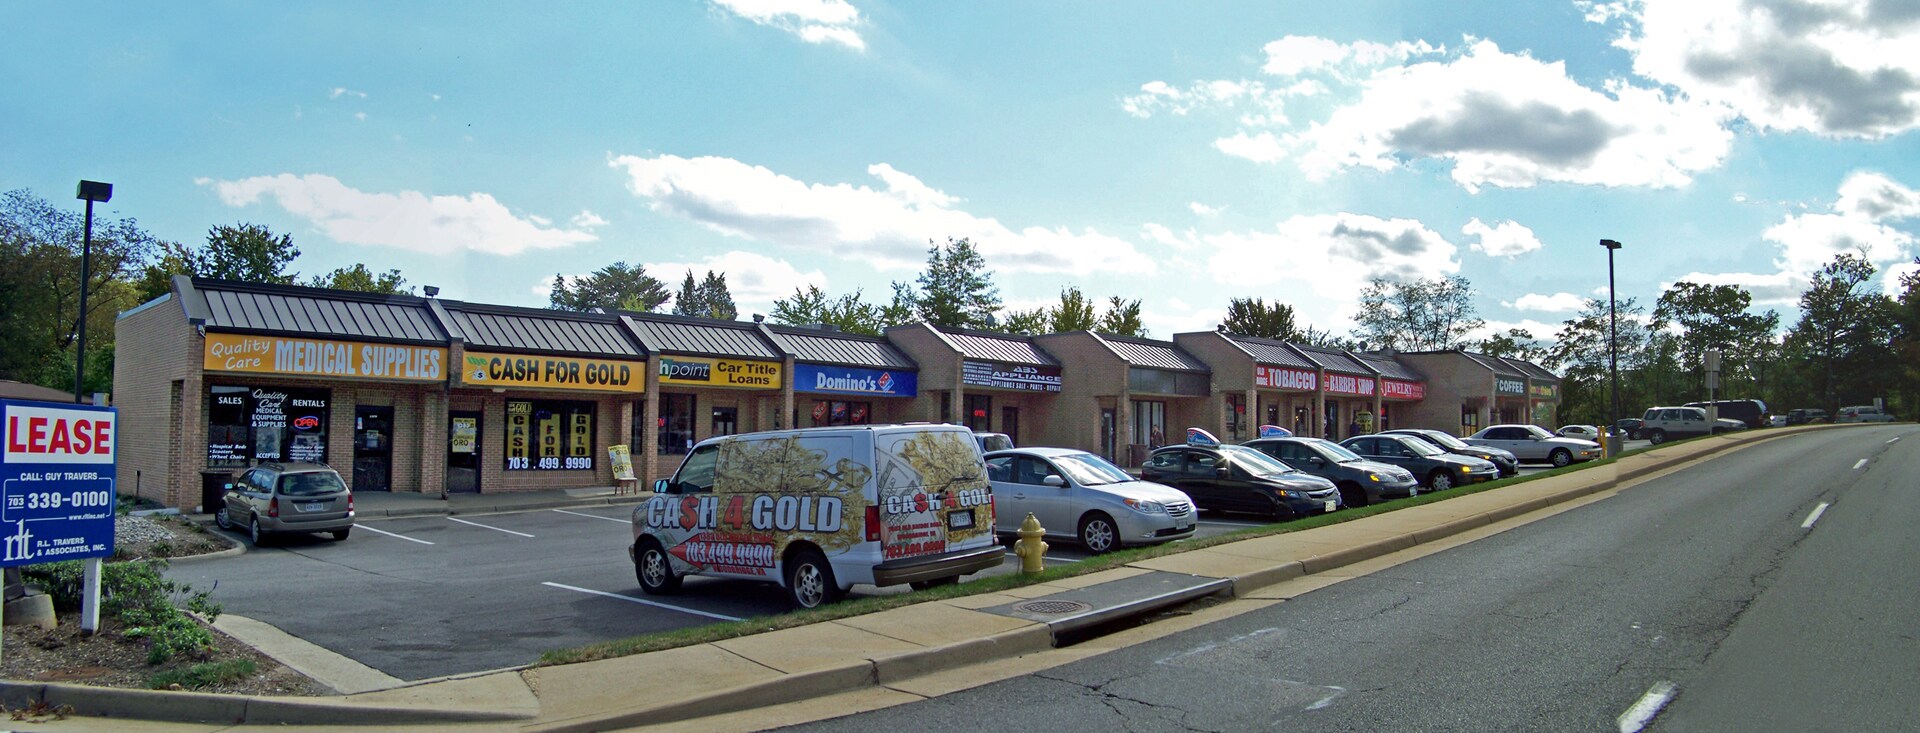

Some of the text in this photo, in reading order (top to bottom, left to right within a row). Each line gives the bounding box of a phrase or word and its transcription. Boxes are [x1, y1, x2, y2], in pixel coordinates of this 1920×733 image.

[211, 340, 270, 356] Quality
[225, 357, 261, 370] Care
[275, 340, 440, 379] MEDICAL SUPPLIES
[489, 357, 631, 386] CASH FOR GOLD
[717, 362, 777, 375] Car Title
[992, 371, 1061, 382] APPLIANCE
[1013, 366, 1038, 374] ABS
[728, 373, 770, 385] Loans
[816, 372, 876, 391] Domino's
[991, 380, 1015, 389] APPLIANCE
[1268, 368, 1316, 390] TOBACCO
[1329, 375, 1374, 394] BARBER SHOP
[1499, 380, 1524, 394] COFFEE
[252, 388, 288, 402] Quality
[1384, 381, 1412, 396] JEWELRY
[294, 418, 318, 427] OPEN
[8, 416, 111, 455] LEASE
[512, 416, 524, 457] CASH
[545, 424, 555, 456] FOR
[576, 416, 586, 456] GOLD
[20, 472, 42, 481] CALL:
[45, 472, 62, 480] GUY
[8, 491, 108, 509] 703 339-0100
[887, 492, 940, 514] CA$H
[945, 492, 956, 508] 4
[647, 495, 842, 532] CA$H 4 GOLD
[3, 519, 35, 561] rlt
[53, 537, 84, 546] TRAVERS
[44, 545, 90, 556] ASSOCIATES,
[684, 541, 774, 567] 703.499.9990
